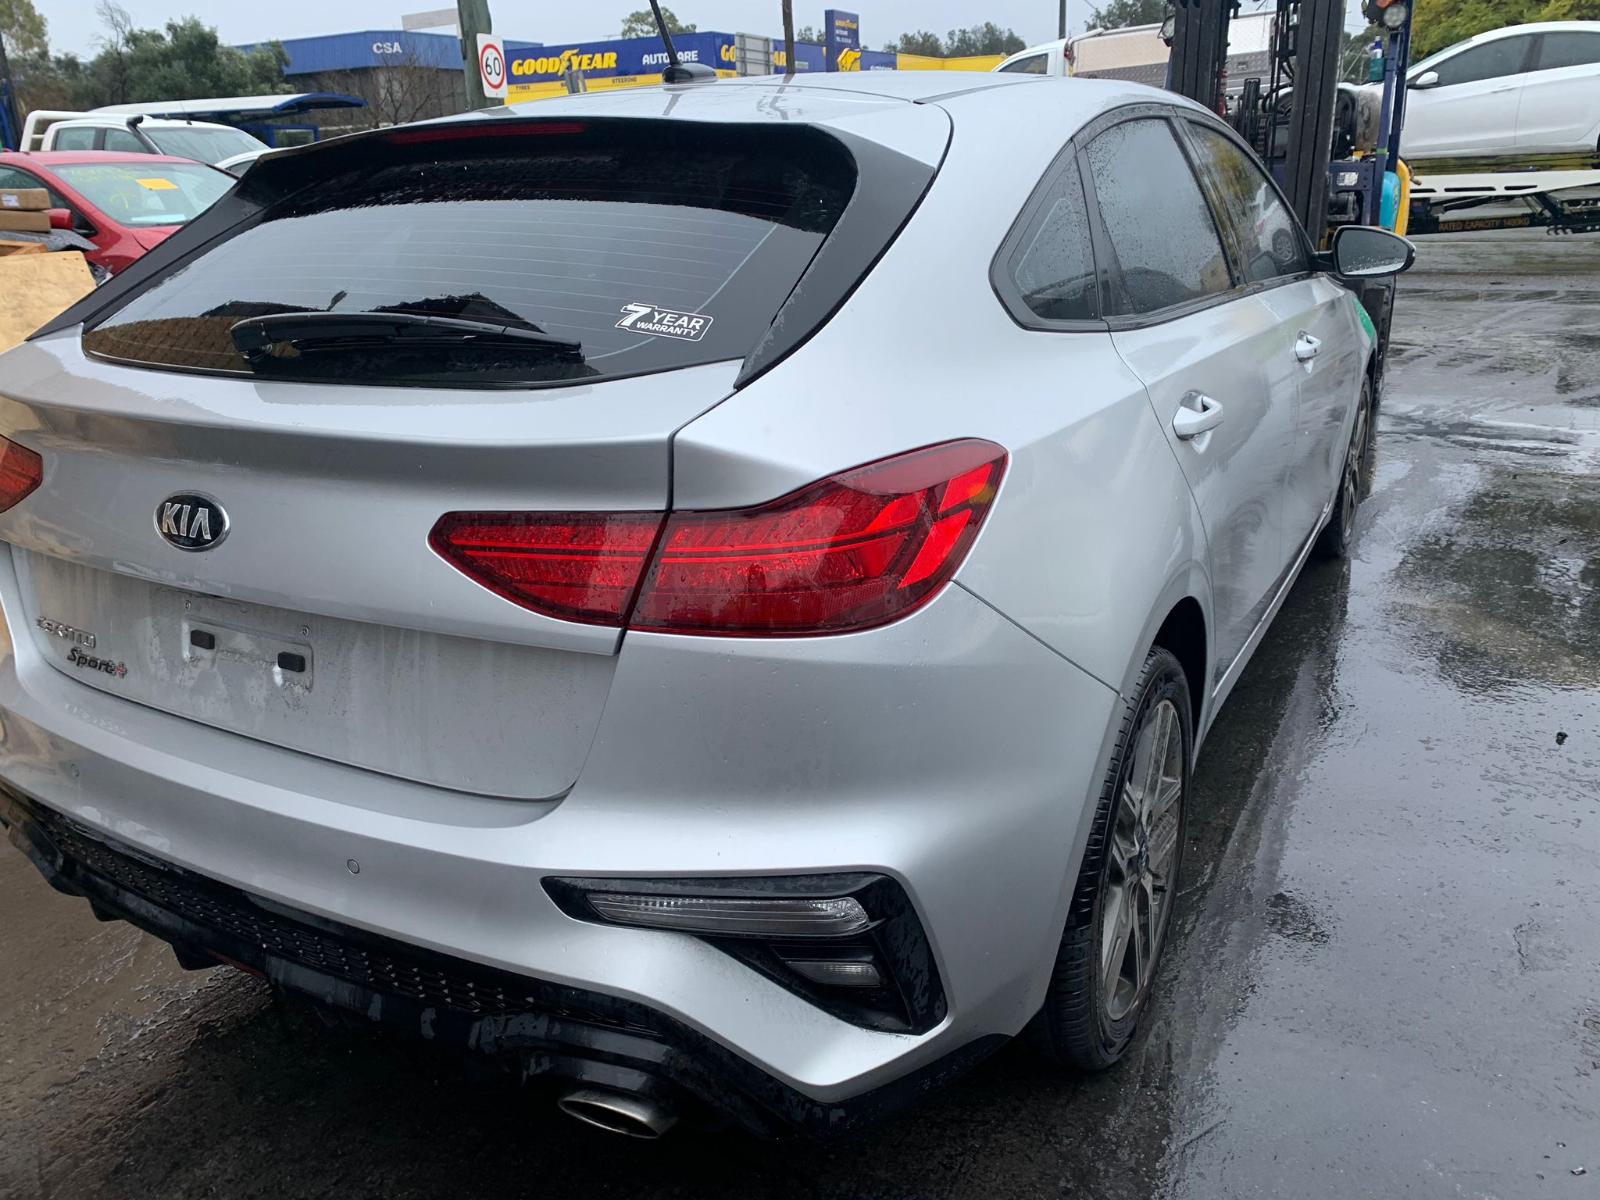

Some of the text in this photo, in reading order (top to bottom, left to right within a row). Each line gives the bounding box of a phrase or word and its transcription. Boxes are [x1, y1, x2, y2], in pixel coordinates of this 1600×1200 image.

[372, 42, 402, 54] CSA
[485, 57, 501, 76] 60
[511, 50, 699, 76] GOODYEAR AUTOARE
[620, 304, 704, 330] 7 YEAR
[636, 321, 698, 337] WARRANTY
[162, 502, 212, 540] KIA
